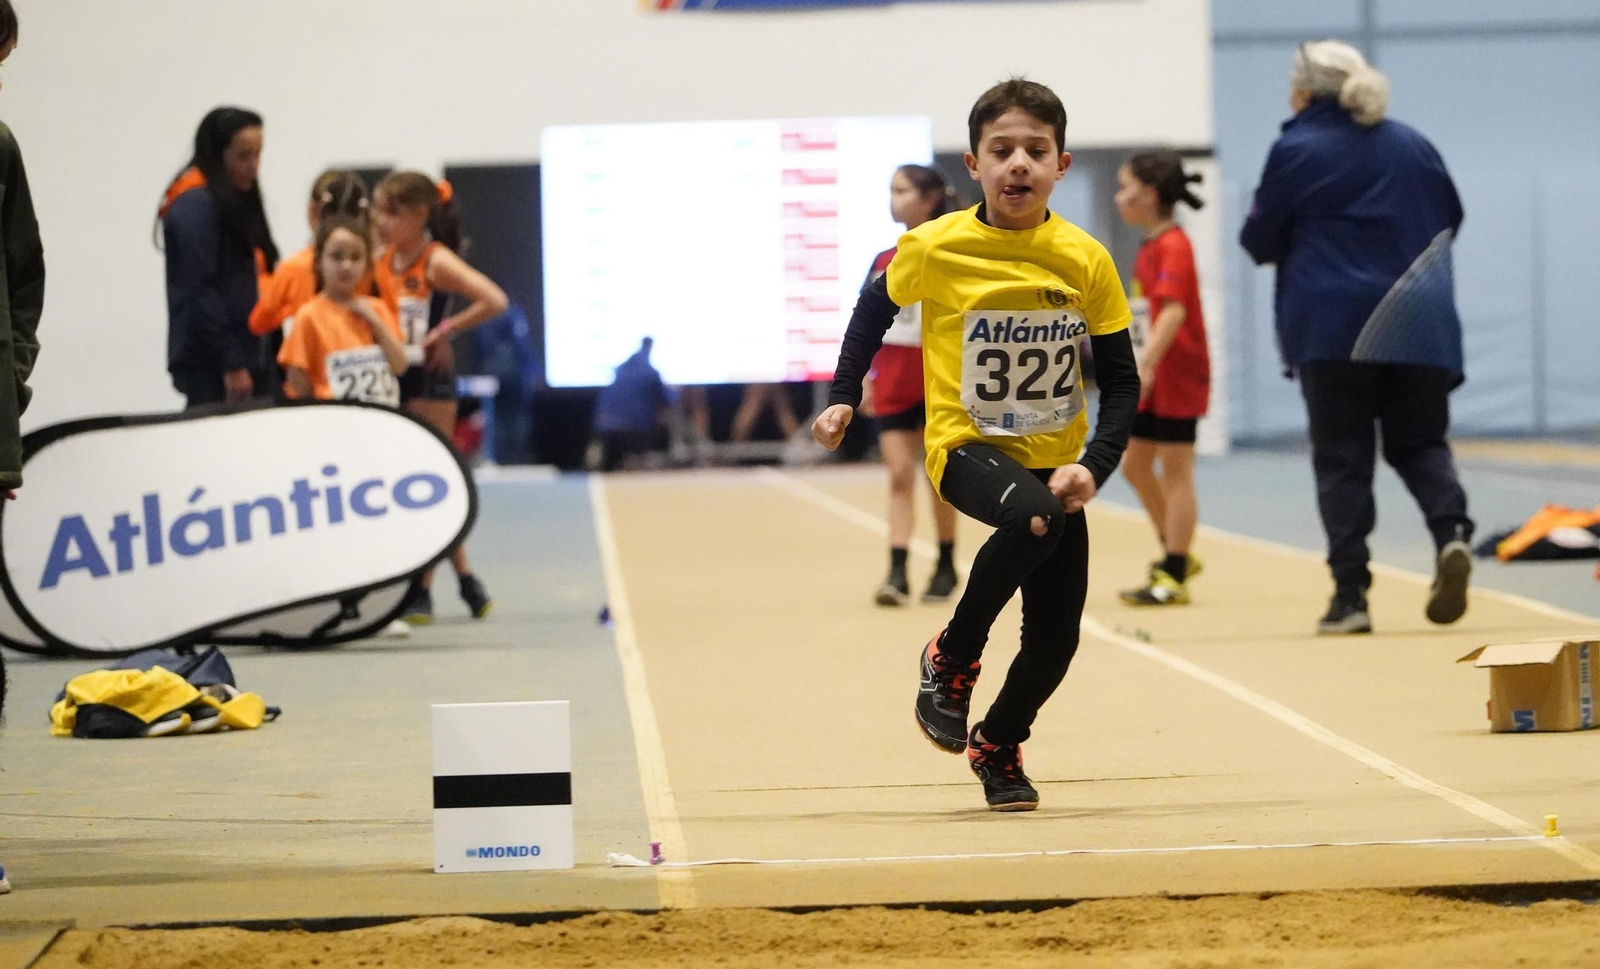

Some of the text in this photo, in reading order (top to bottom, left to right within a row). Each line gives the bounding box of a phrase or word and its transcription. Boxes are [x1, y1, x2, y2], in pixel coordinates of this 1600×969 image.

[968, 315, 1087, 344] Atlántico
[975, 345, 1075, 401] 322
[38, 463, 449, 591] Atlántico
[478, 845, 541, 858] MONDO
